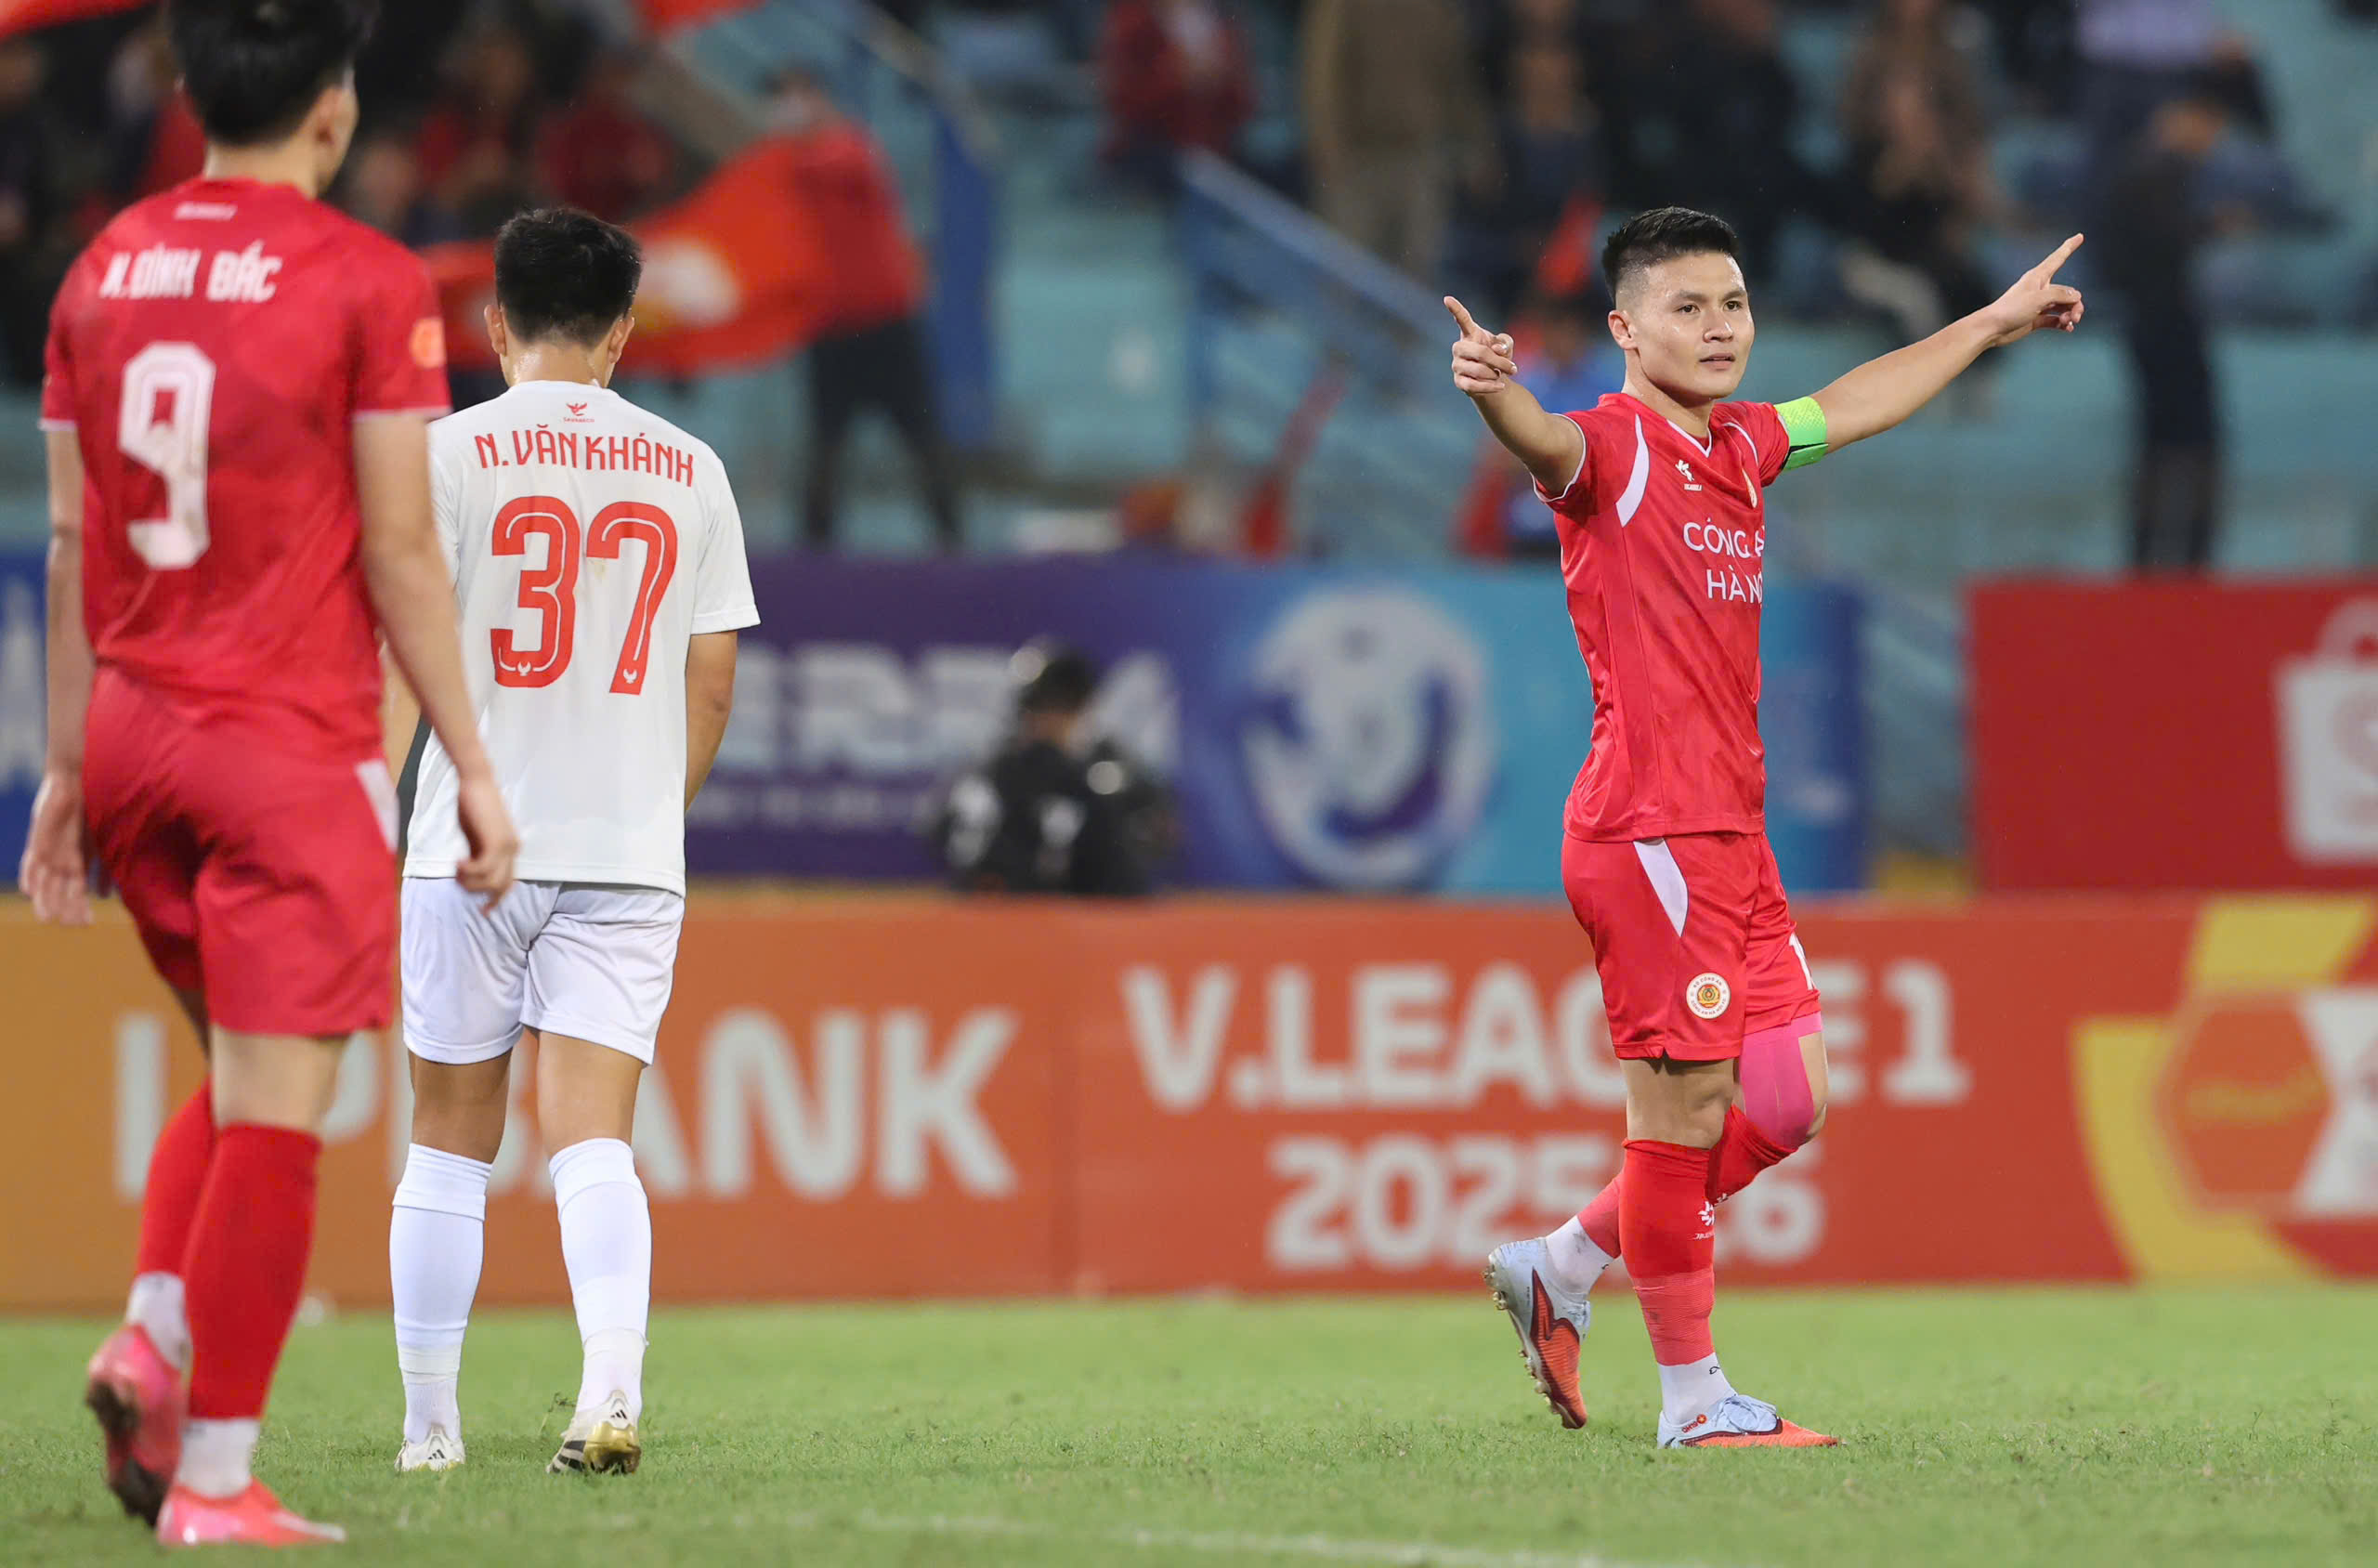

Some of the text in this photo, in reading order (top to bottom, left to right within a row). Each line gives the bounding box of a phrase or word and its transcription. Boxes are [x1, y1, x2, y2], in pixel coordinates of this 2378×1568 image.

[118, 341, 216, 569] 9
[584, 432, 694, 488] KHÁNH
[490, 495, 678, 696] 37
[1882, 960, 1973, 1101] 1
